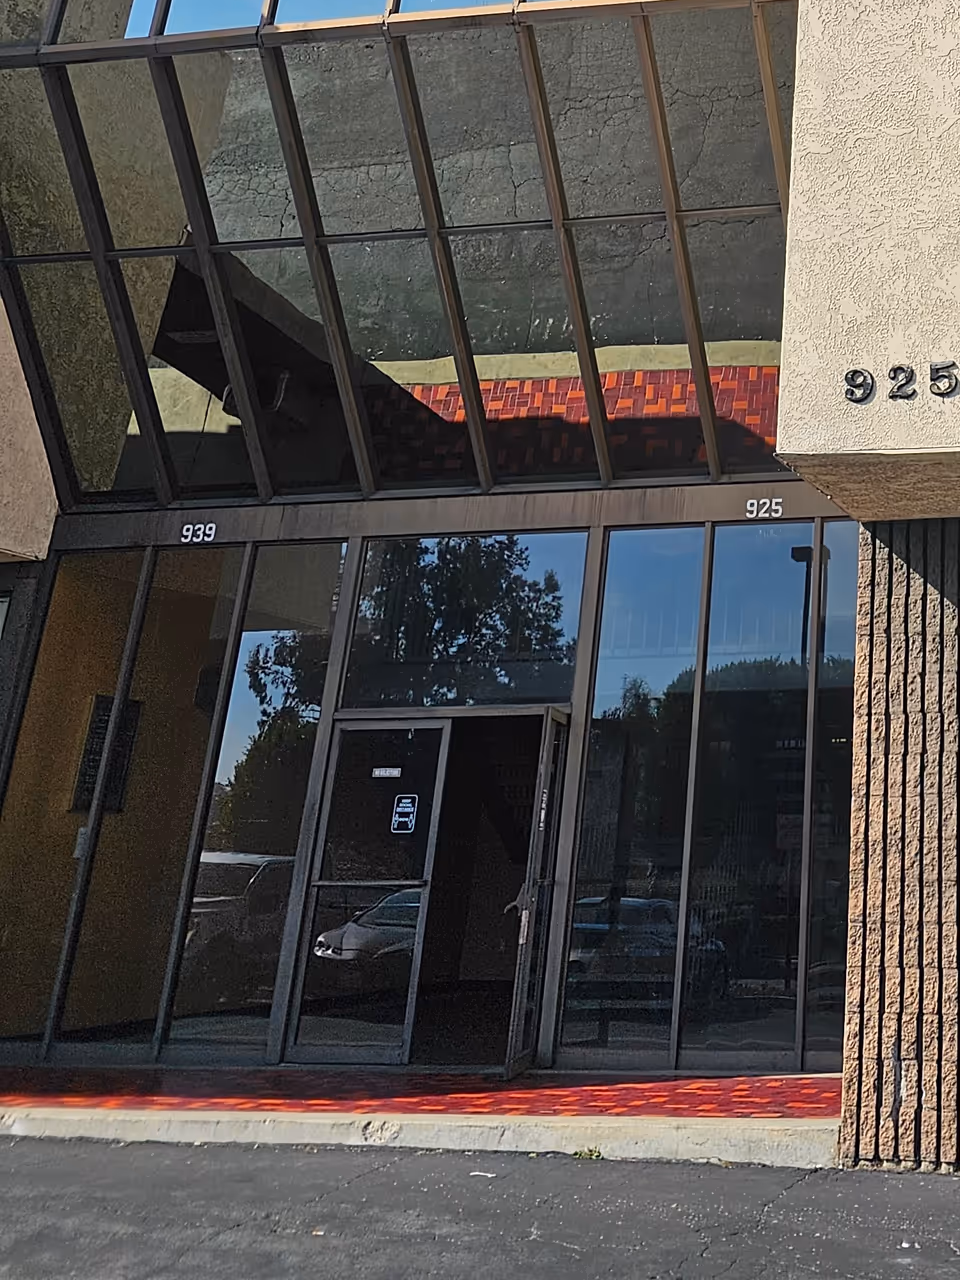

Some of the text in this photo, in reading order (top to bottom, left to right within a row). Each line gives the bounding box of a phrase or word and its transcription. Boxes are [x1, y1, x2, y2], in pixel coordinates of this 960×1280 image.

[845, 361, 959, 403] 925
[745, 498, 783, 518] 925
[180, 523, 216, 542] 939
